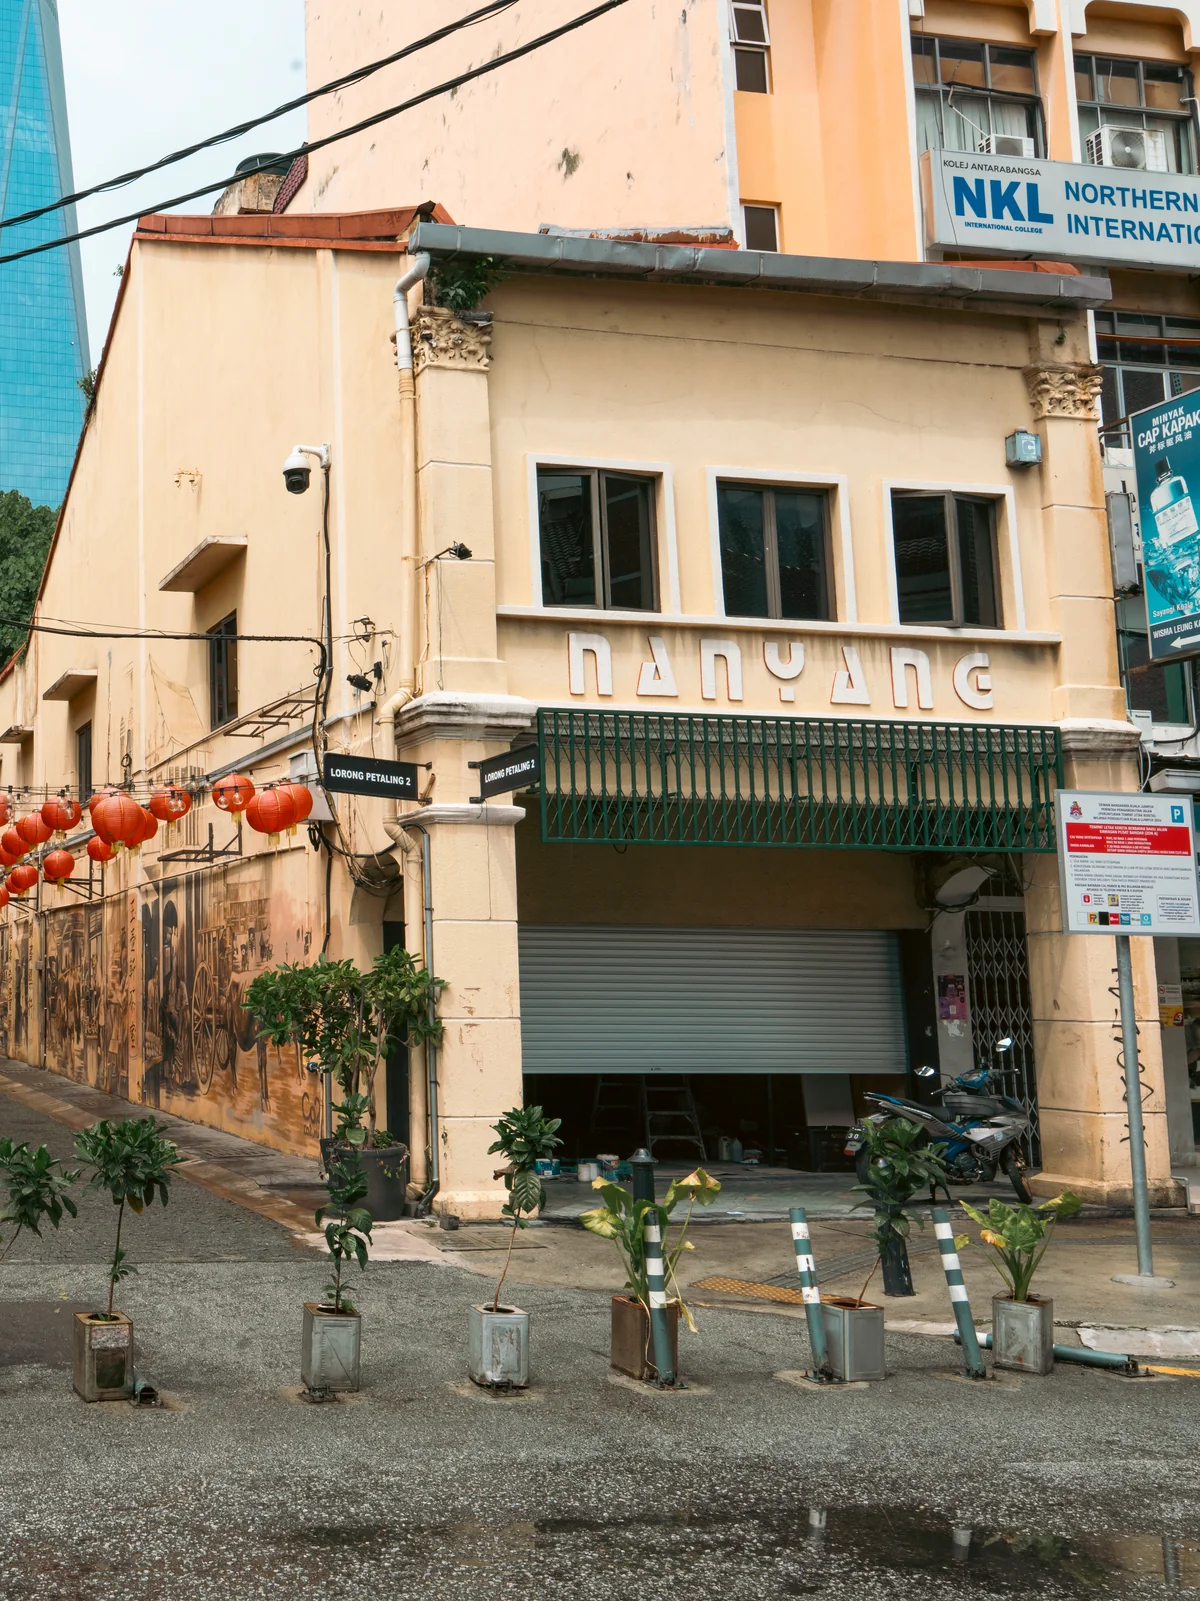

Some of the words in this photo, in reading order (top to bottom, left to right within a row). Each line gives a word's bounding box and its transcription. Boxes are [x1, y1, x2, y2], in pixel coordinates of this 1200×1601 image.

[943, 158, 969, 170] KOLEJ
[970, 162, 1042, 177] ANTARABANGSA
[952, 175, 1054, 225] NKL
[1064, 180, 1199, 213] NORTHERN
[964, 221, 1014, 232] INTERNATIONAL
[1014, 225, 1043, 235] COLLEGE
[1152, 405, 1185, 427] MINYAK
[1138, 427, 1160, 448] CAP
[1162, 409, 1200, 439] KAPAK
[1152, 604, 1176, 618] Sayangi
[1152, 627, 1174, 639] WISMA
[1173, 621, 1193, 634] LEUNG
[567, 632, 994, 711] NANYANG
[330, 767, 365, 780] LORONG
[365, 772, 405, 786] PETALING
[405, 777, 412, 787] 2
[484, 769, 505, 784] LORONG
[504, 761, 531, 778] PETALING
[529, 758, 536, 769] 2
